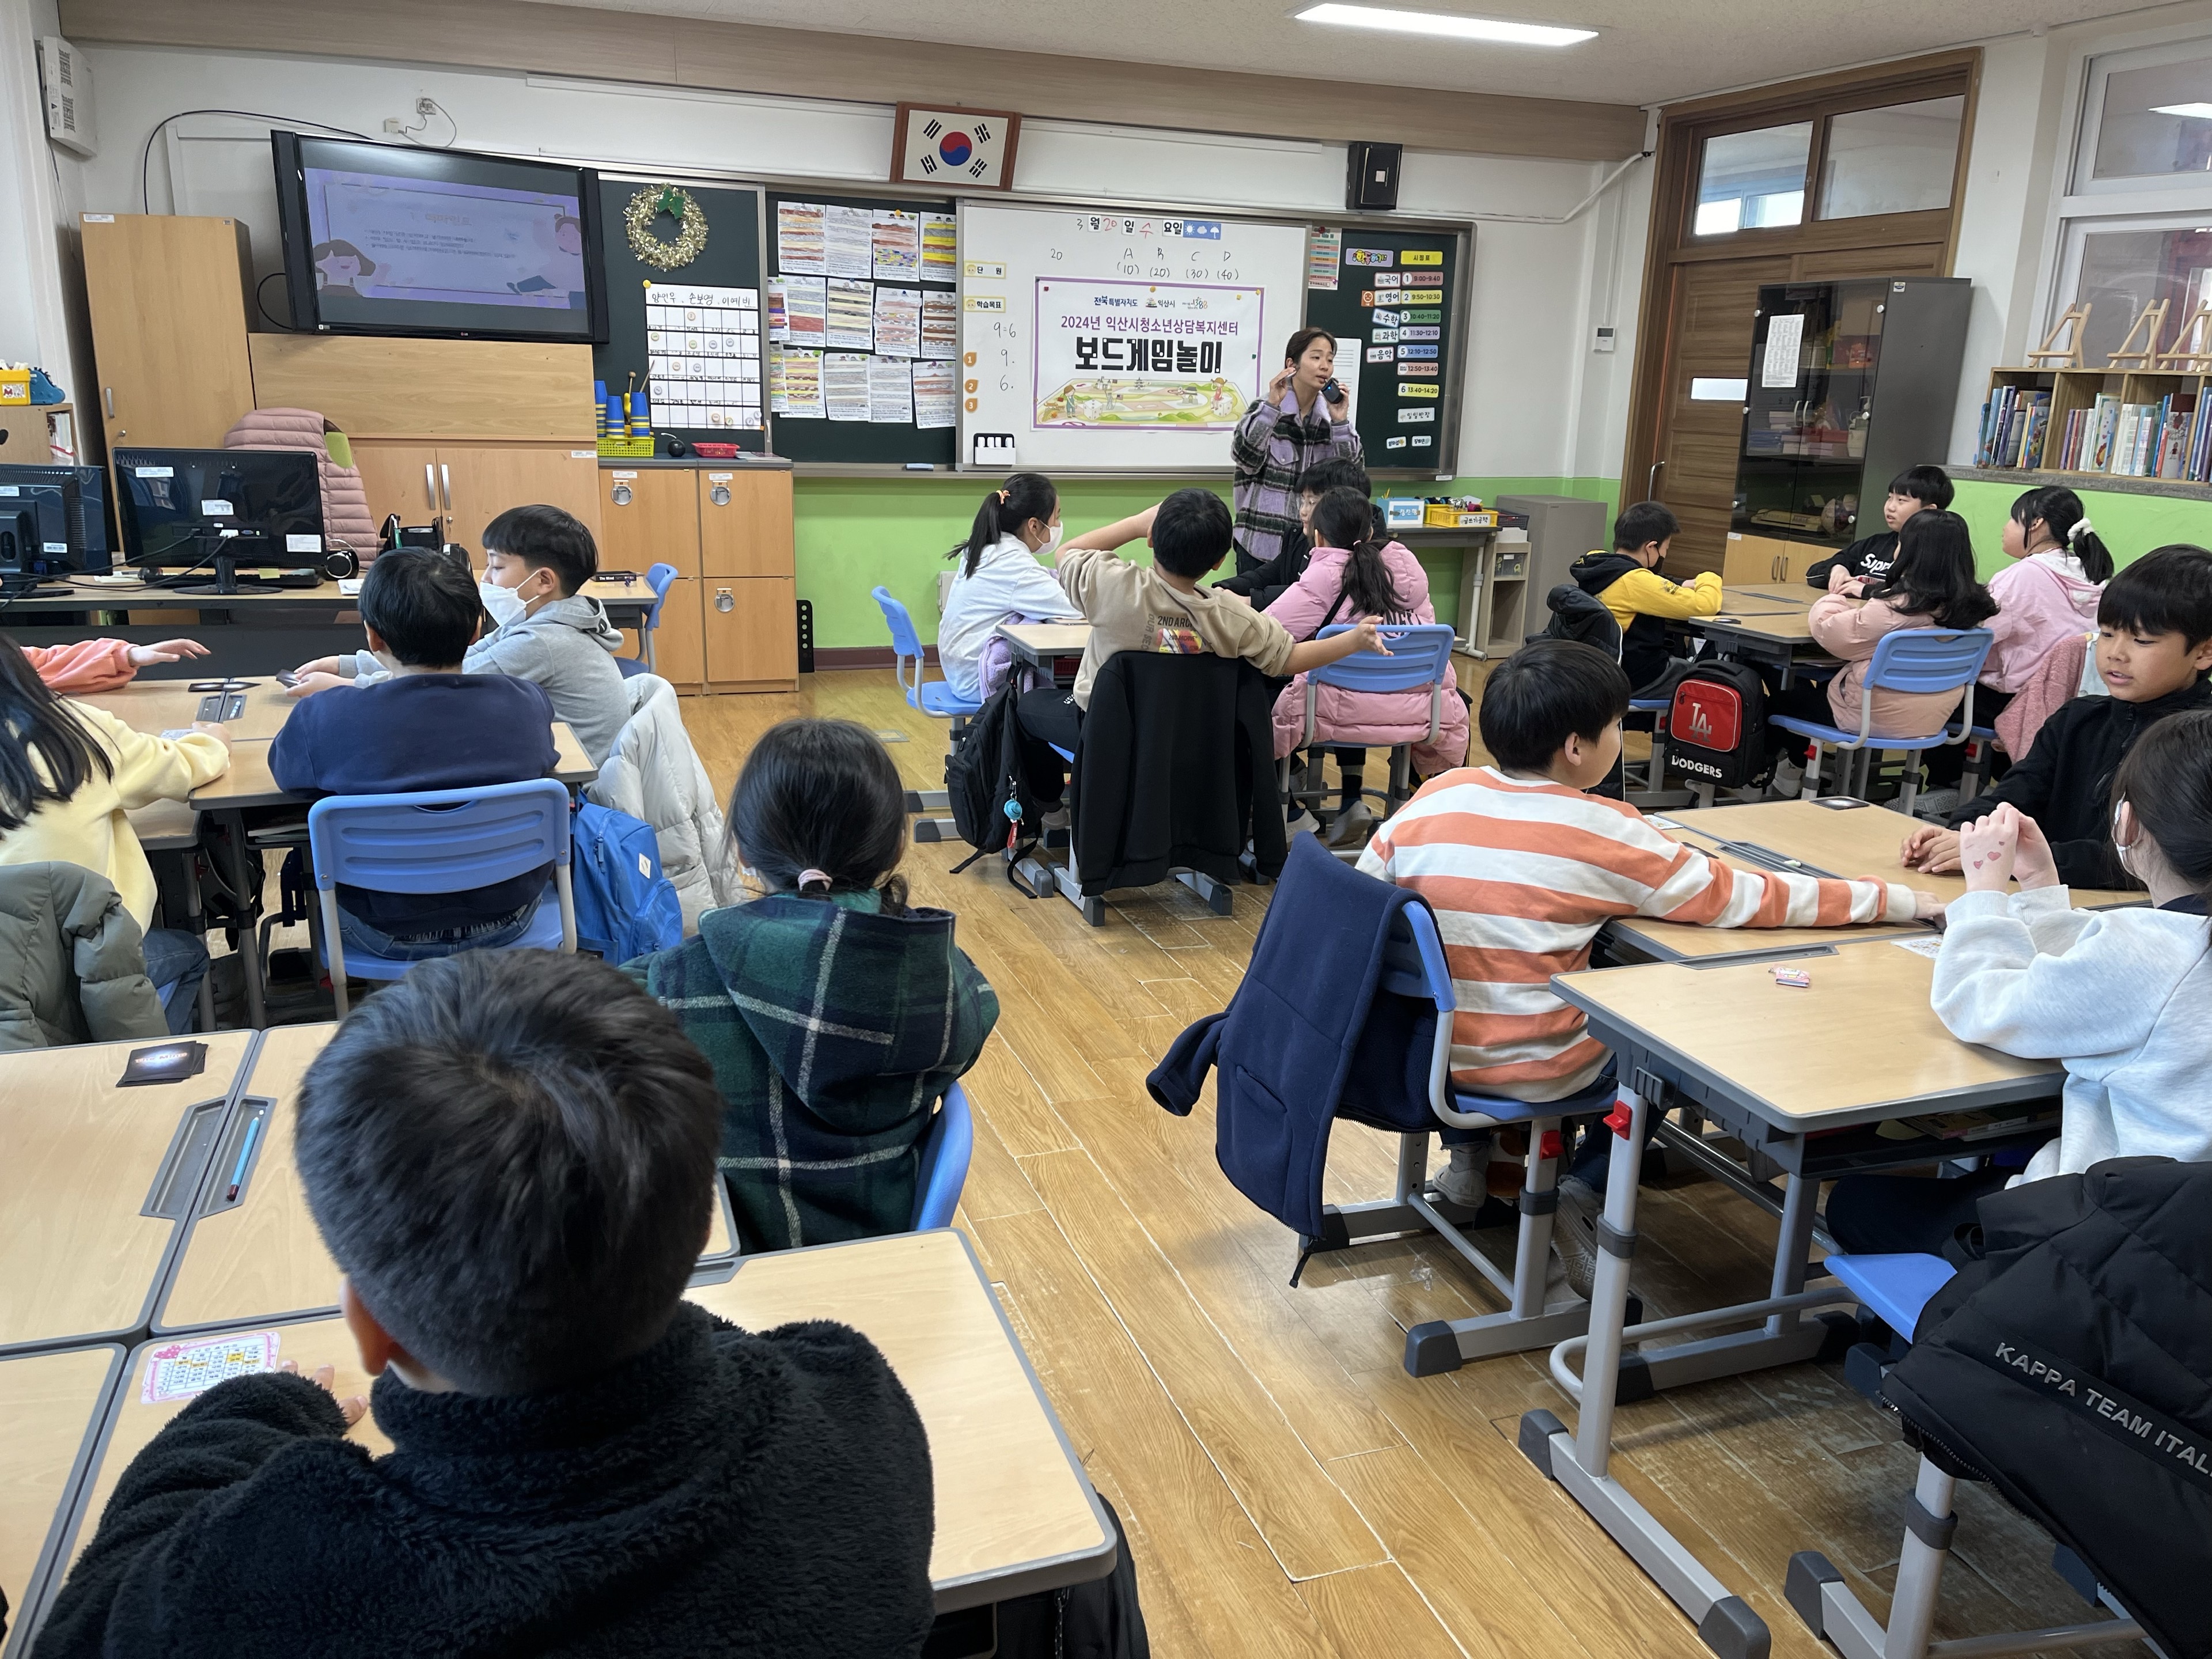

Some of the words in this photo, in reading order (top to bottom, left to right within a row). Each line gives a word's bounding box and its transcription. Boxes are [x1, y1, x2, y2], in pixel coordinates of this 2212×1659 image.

[1077, 218, 1083, 230] 3
[1090, 216, 1100, 230] 월
[1103, 218, 1117, 231] 20
[1124, 220, 1134, 233] 일
[1139, 222, 1153, 239] 수
[1164, 222, 1181, 235] 요일
[1051, 248, 1063, 260] 20
[1123, 248, 1134, 259] A
[1191, 251, 1200, 262] C
[1224, 251, 1230, 262] D
[976, 266, 983, 274] 단
[995, 267, 1002, 275] 원
[1117, 262, 1139, 275] (10)
[1150, 267, 1170, 278] (20)
[1186, 268, 1209, 279] (30)
[1217, 268, 1239, 280] (40)
[1385, 275, 1399, 285] 국어
[689, 292, 713, 305] 손보영
[722, 296, 756, 308] 이예빈
[1094, 295, 1138, 308] 전북특별자치도
[1157, 300, 1175, 308] 익산시
[1385, 291, 1399, 302] 영어
[976, 300, 1002, 309] 학습목표
[1383, 313, 1398, 325] 수학
[1061, 316, 1100, 331] 2024년
[1105, 316, 1238, 336] 익산시청소년상담복지센터
[1382, 331, 1397, 340] 과학
[1075, 336, 1222, 373] 보드게임놀이
[1377, 349, 1392, 360] 음악
[1407, 411, 1430, 420] 일일반장
[1464, 516, 1488, 525] 글쓰기공책
[1158, 616, 1173, 626] 2ND
[1688, 702, 1713, 743] LA
[1671, 755, 1722, 778] DODGERS
[1995, 1342, 2076, 1397] KAPPA
[2085, 1388, 2153, 1438] TEAM
[2154, 1430, 2212, 1478] ITAL
